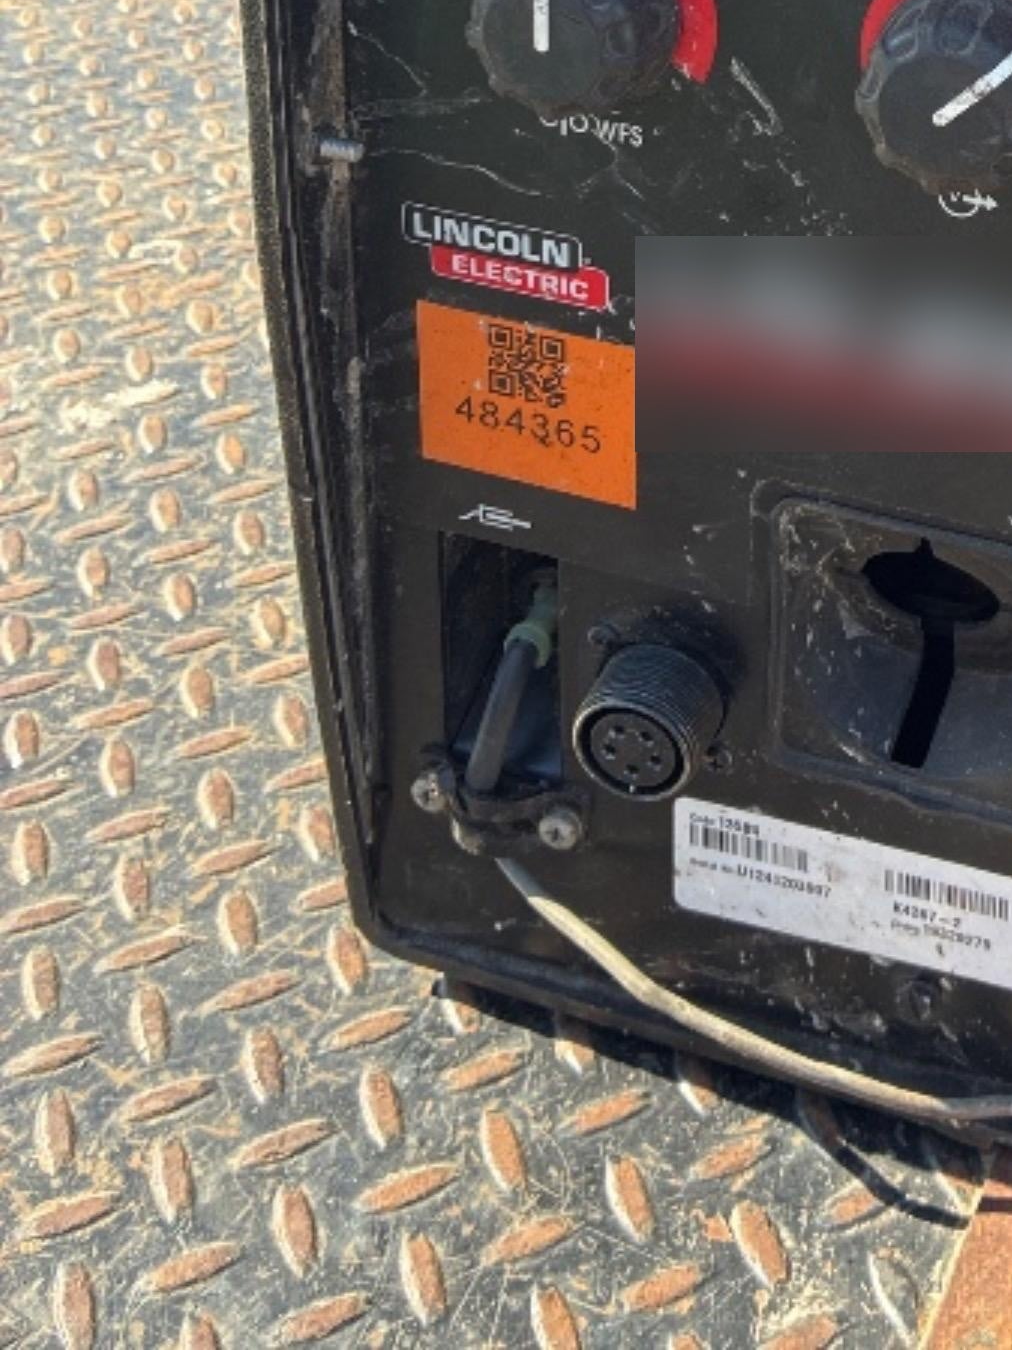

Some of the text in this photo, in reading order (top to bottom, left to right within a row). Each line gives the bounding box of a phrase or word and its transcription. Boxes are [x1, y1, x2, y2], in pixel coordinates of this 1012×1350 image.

[412, 211, 570, 268] LINCOLN
[452, 254, 589, 300] ELECTRIC
[455, 395, 601, 453] 484365
